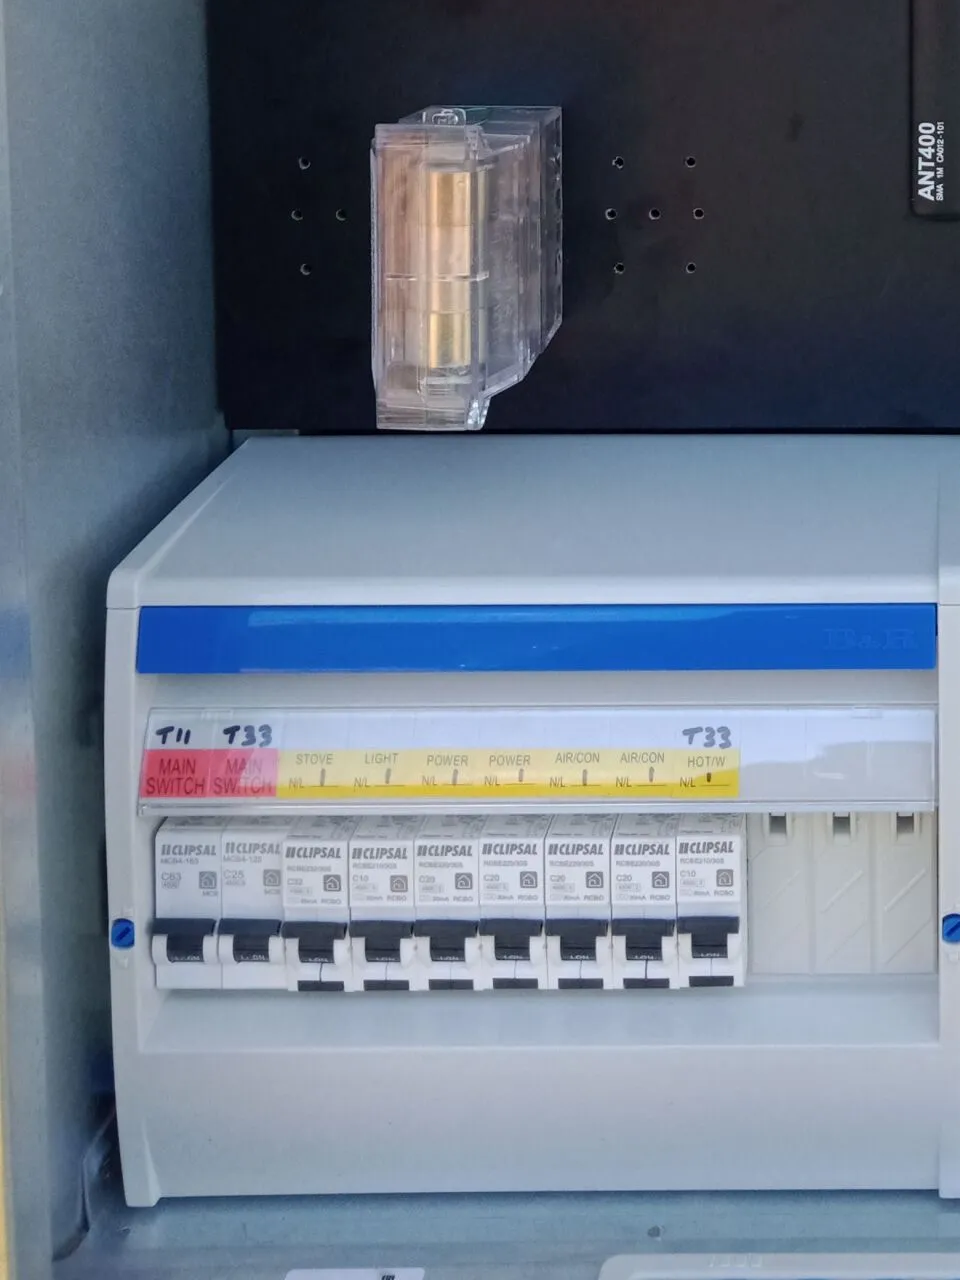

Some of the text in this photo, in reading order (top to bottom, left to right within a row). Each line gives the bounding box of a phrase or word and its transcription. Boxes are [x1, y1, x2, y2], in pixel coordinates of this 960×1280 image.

[918, 123, 935, 201] ANT400
[936, 167, 944, 178] 1M
[223, 724, 272, 747] T33
[682, 727, 732, 749] T33
[296, 753, 333, 765] STOVE
[365, 753, 399, 764] LIGHT
[427, 755, 468, 766] POWER
[489, 755, 530, 766] POWER
[555, 752, 600, 763] AIR/CON
[620, 752, 664, 763] AIR/CON
[688, 756, 725, 768] HOT/W
[160, 759, 195, 774] MAIN
[227, 759, 262, 773] MAIN
[146, 777, 205, 794] SWITCH
[213, 777, 271, 794] SWITCH
[354, 777, 370, 787] N/L
[422, 776, 437, 786] N/L
[485, 775, 500, 786] N/L
[550, 776, 565, 787] N/L
[616, 776, 632, 787] N/L
[680, 776, 696, 788] N/L
[172, 845, 216, 855] CLIPSAL
[236, 842, 280, 854] CLIPSAL
[297, 847, 341, 858] CLIPSAL
[428, 845, 472, 856] CLIPSAL
[493, 844, 537, 855] CLIPSAL
[559, 844, 603, 855] CLIPSAL
[626, 844, 669, 855] CLIPSAL
[689, 841, 734, 853] CLIPSAL
[363, 848, 407, 859] CLIPSAL
